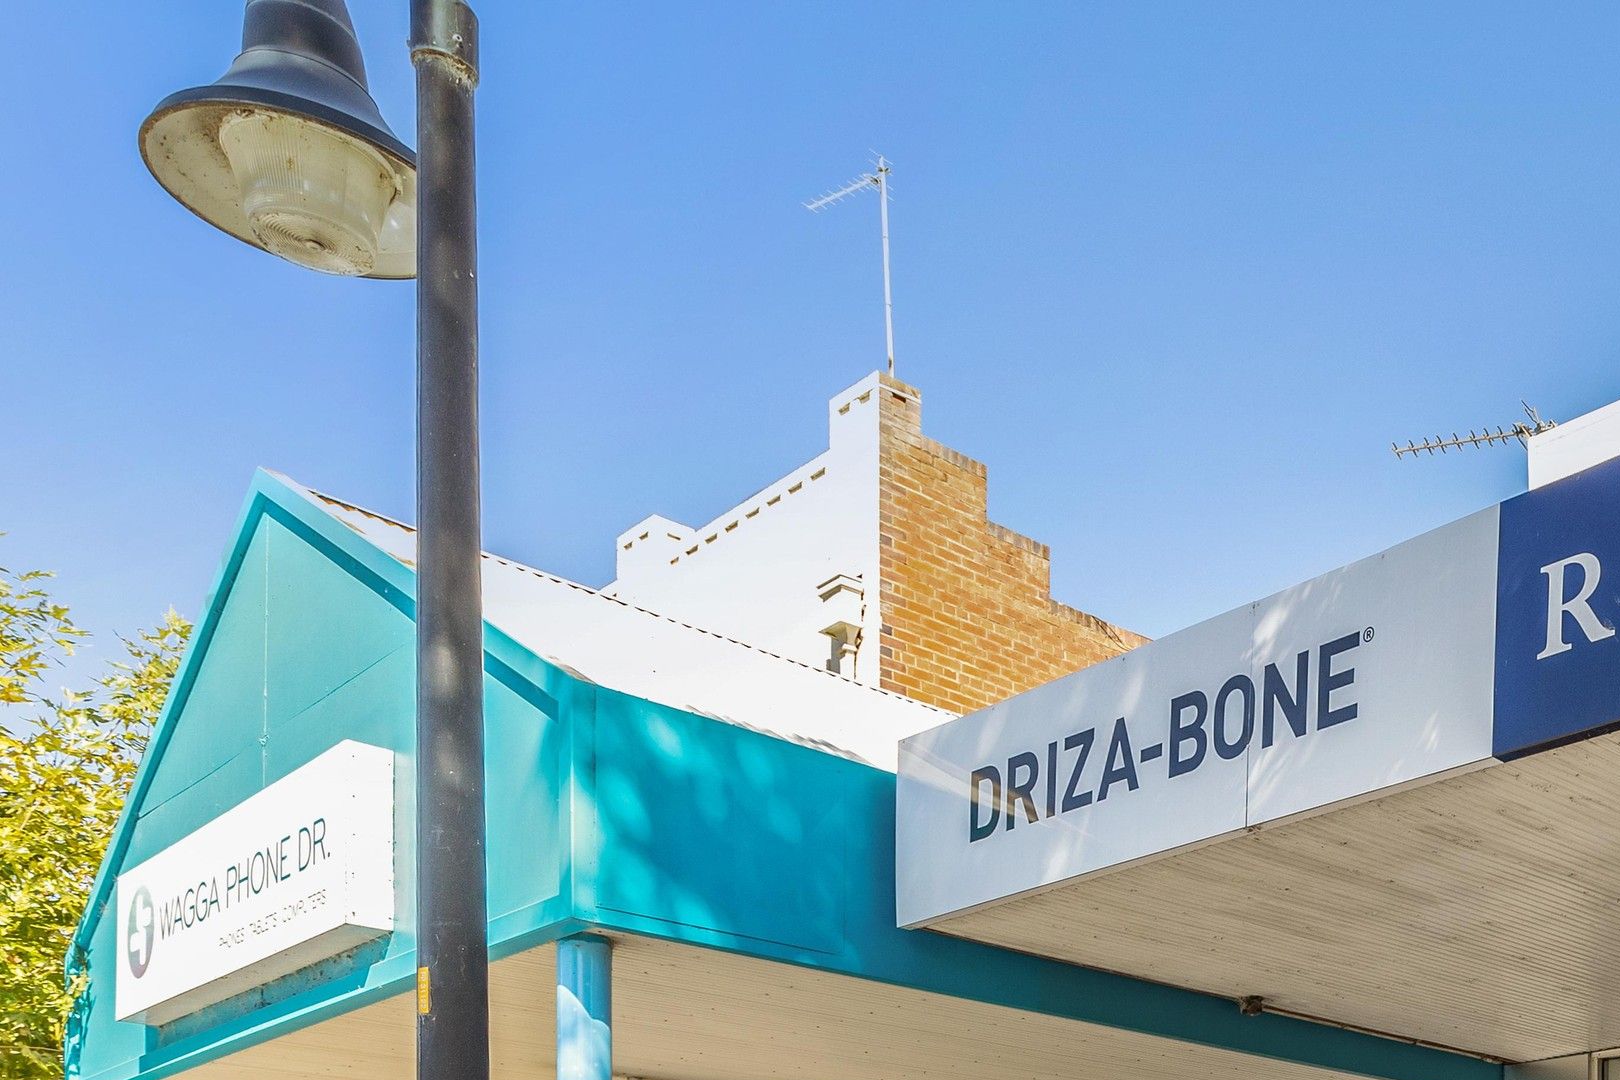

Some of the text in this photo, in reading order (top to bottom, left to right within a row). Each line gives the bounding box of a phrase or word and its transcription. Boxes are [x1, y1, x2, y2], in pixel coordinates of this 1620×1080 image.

[160, 817, 331, 940] WAGGA PHONE DR.
